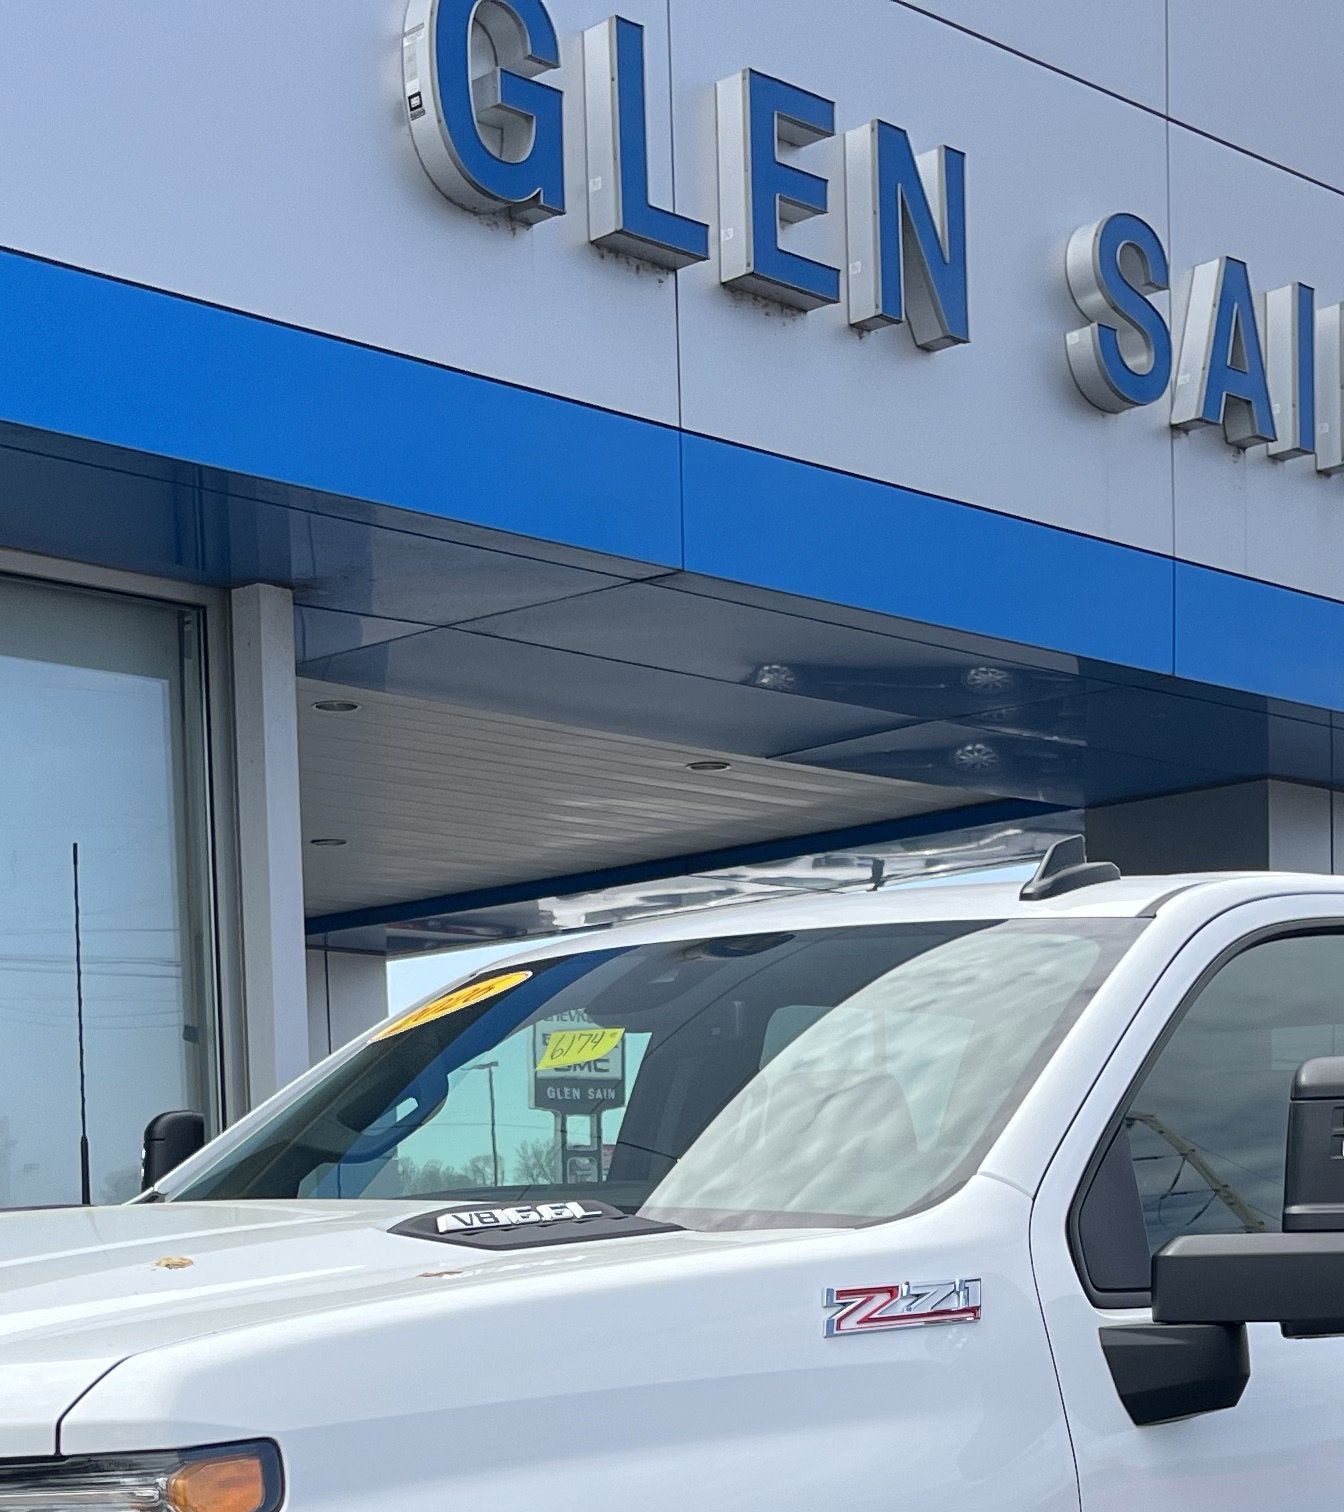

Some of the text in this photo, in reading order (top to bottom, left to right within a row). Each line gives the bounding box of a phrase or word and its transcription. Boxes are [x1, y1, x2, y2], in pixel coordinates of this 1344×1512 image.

[404, 0, 971, 353] GLEN
[546, 1086, 616, 1100] GLEN SAIN
[822, 1276, 983, 1337] Z71
